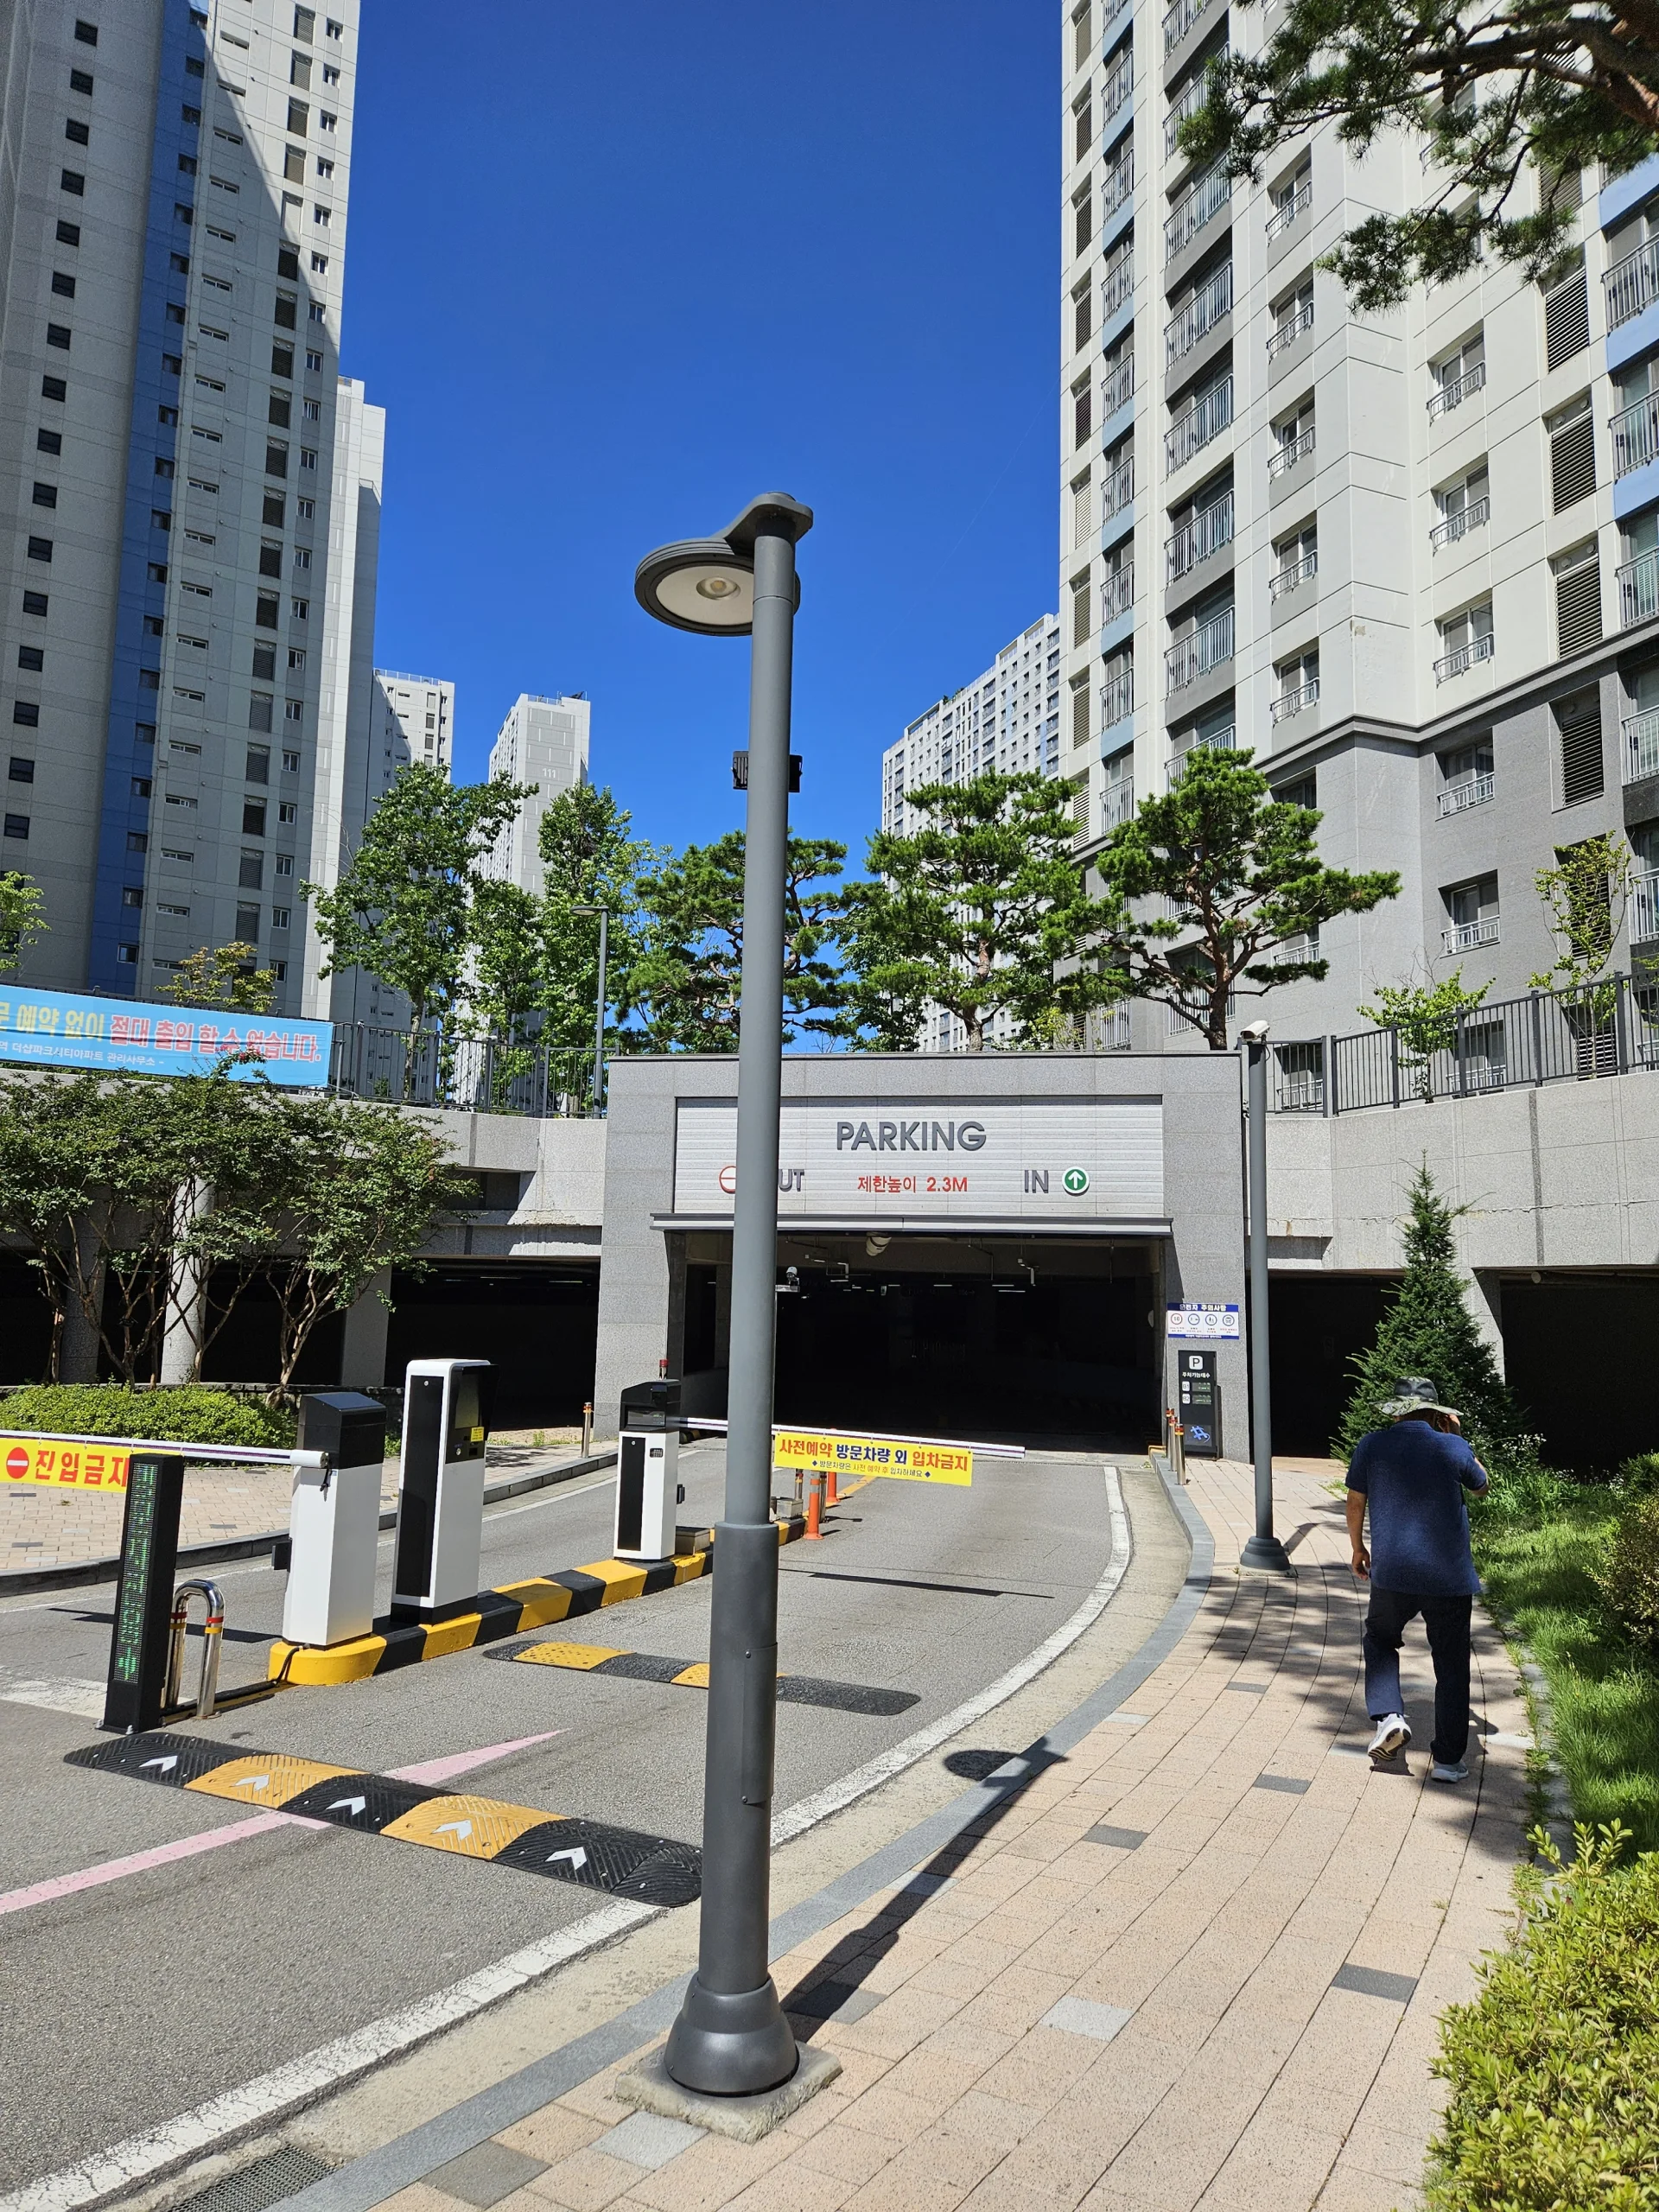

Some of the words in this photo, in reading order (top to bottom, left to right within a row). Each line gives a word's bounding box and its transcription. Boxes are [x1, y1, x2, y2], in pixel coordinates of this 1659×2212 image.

[543, 767, 556, 778] 111
[16, 1004, 60, 1037] 예약
[65, 1009, 105, 1042] 없이
[111, 1014, 150, 1047] 절대
[155, 1020, 194, 1052] 출입
[199, 1024, 219, 1054] 할
[223, 1027, 241, 1055] 수
[12, 1043, 104, 1061] 더샵파크시티아파트
[107, 1052, 156, 1066] 관리사무소
[836, 1121, 987, 1151] PARKING
[779, 1168, 805, 1192] UT
[858, 1175, 917, 1193] 제한높이
[926, 1176, 968, 1192] 2.3M
[1024, 1169, 1049, 1194] IN
[1192, 1357, 1200, 1368] P
[779, 1439, 833, 1459] 사전예약
[836, 1444, 891, 1464] 방문차량
[894, 1449, 907, 1465] 외
[912, 1451, 968, 1471] 입차금지
[35, 1449, 130, 1488] 진입금지
[819, 1460, 851, 1471] 방문차량은
[853, 1463, 866, 1472] 사전
[867, 1465, 880, 1474] 예약
[890, 1466, 923, 1478] 입차하세요
